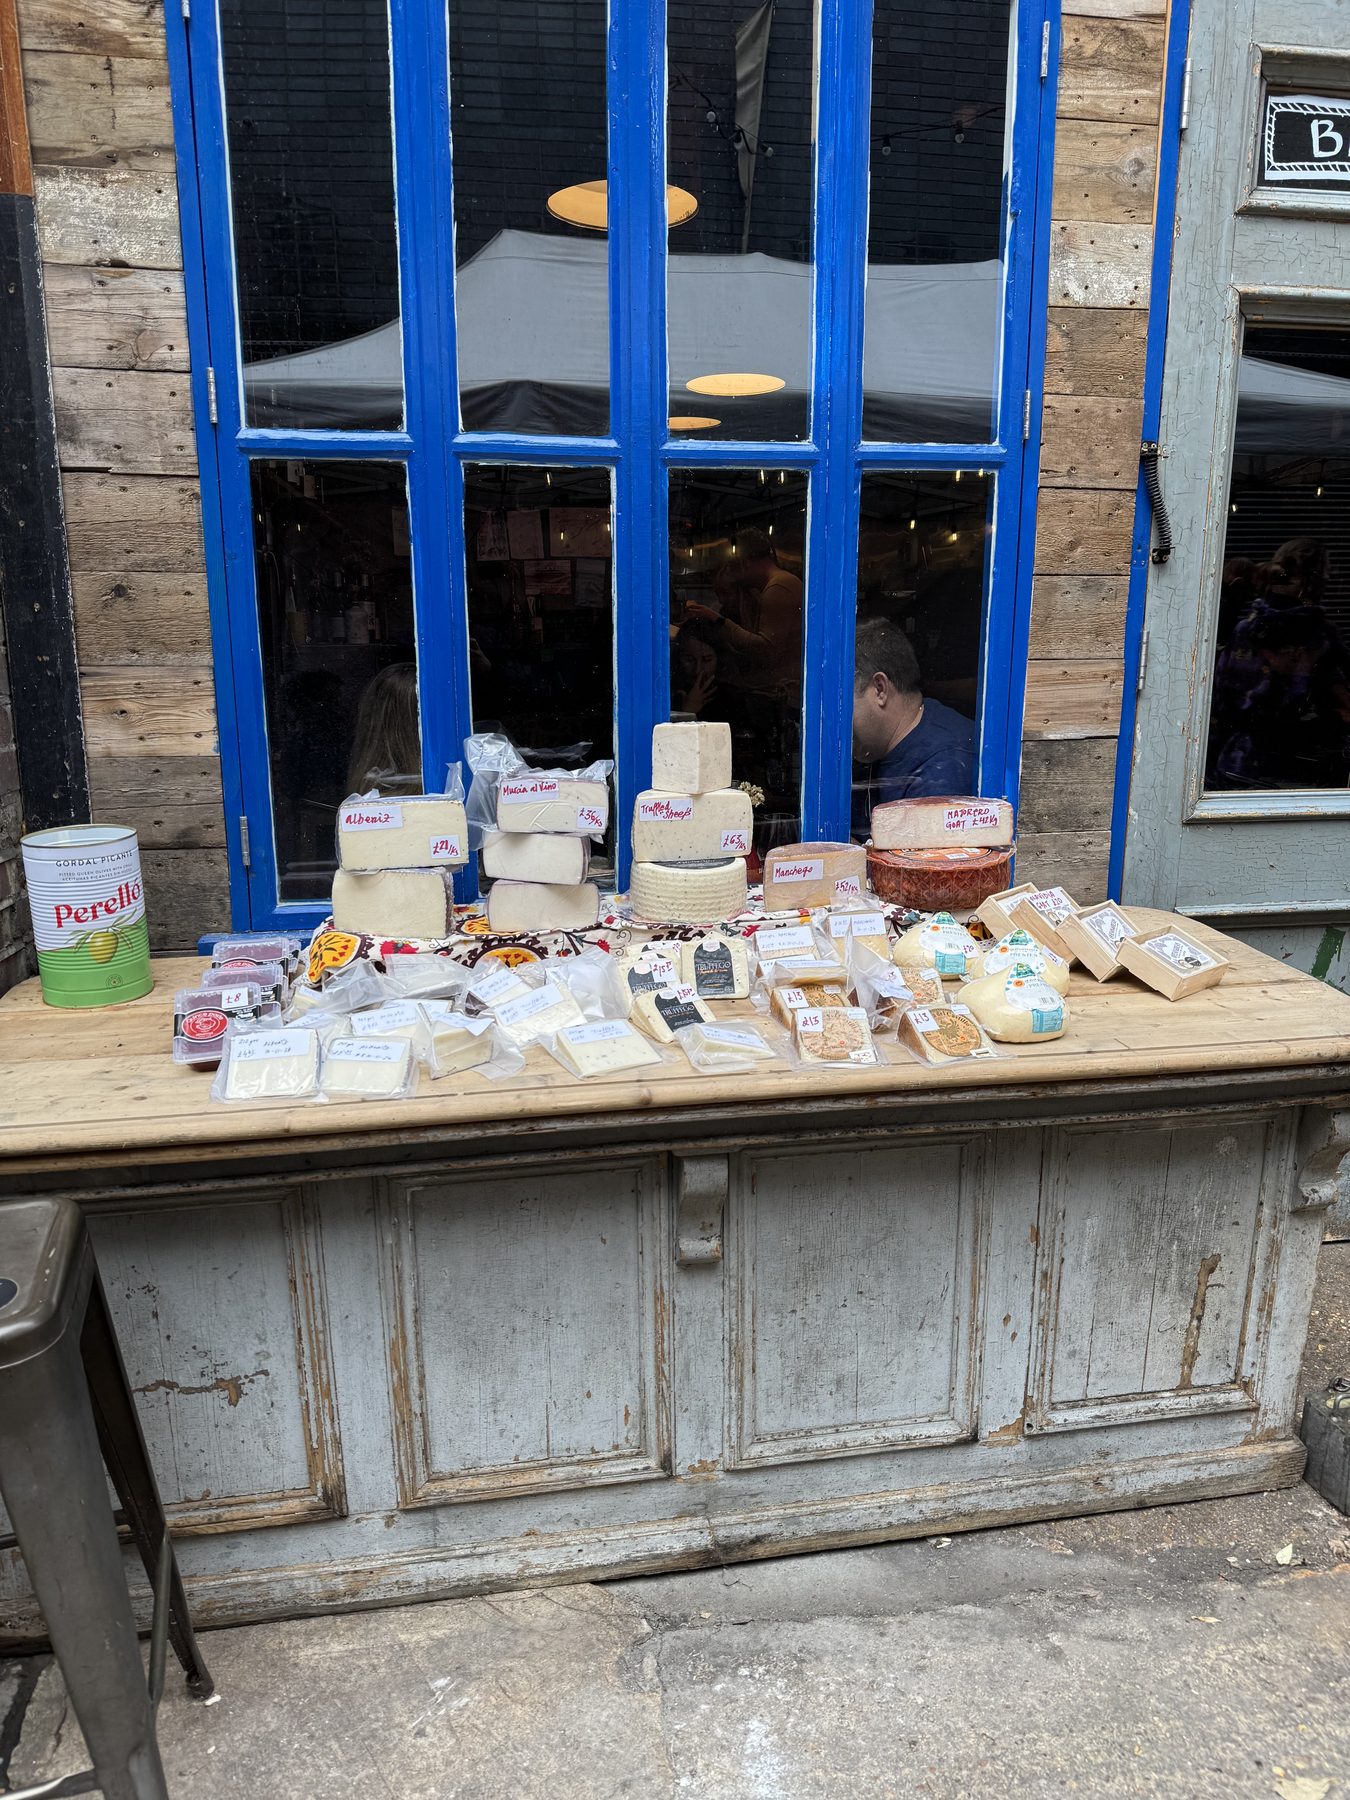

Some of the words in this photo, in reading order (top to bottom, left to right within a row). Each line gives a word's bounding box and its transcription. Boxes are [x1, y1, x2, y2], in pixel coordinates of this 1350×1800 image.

[1310, 118, 1350, 158] B
[539, 781, 557, 791] Vino
[641, 800, 671, 817] Truffled
[945, 819, 966, 830] GOAT
[55, 858, 97, 867] GORDAL
[102, 850, 133, 863] PICANTE
[775, 865, 813, 878] Manchego
[54, 878, 142, 929] Perelló
[225, 992, 242, 1004] £8
[913, 1012, 930, 1025] £13
